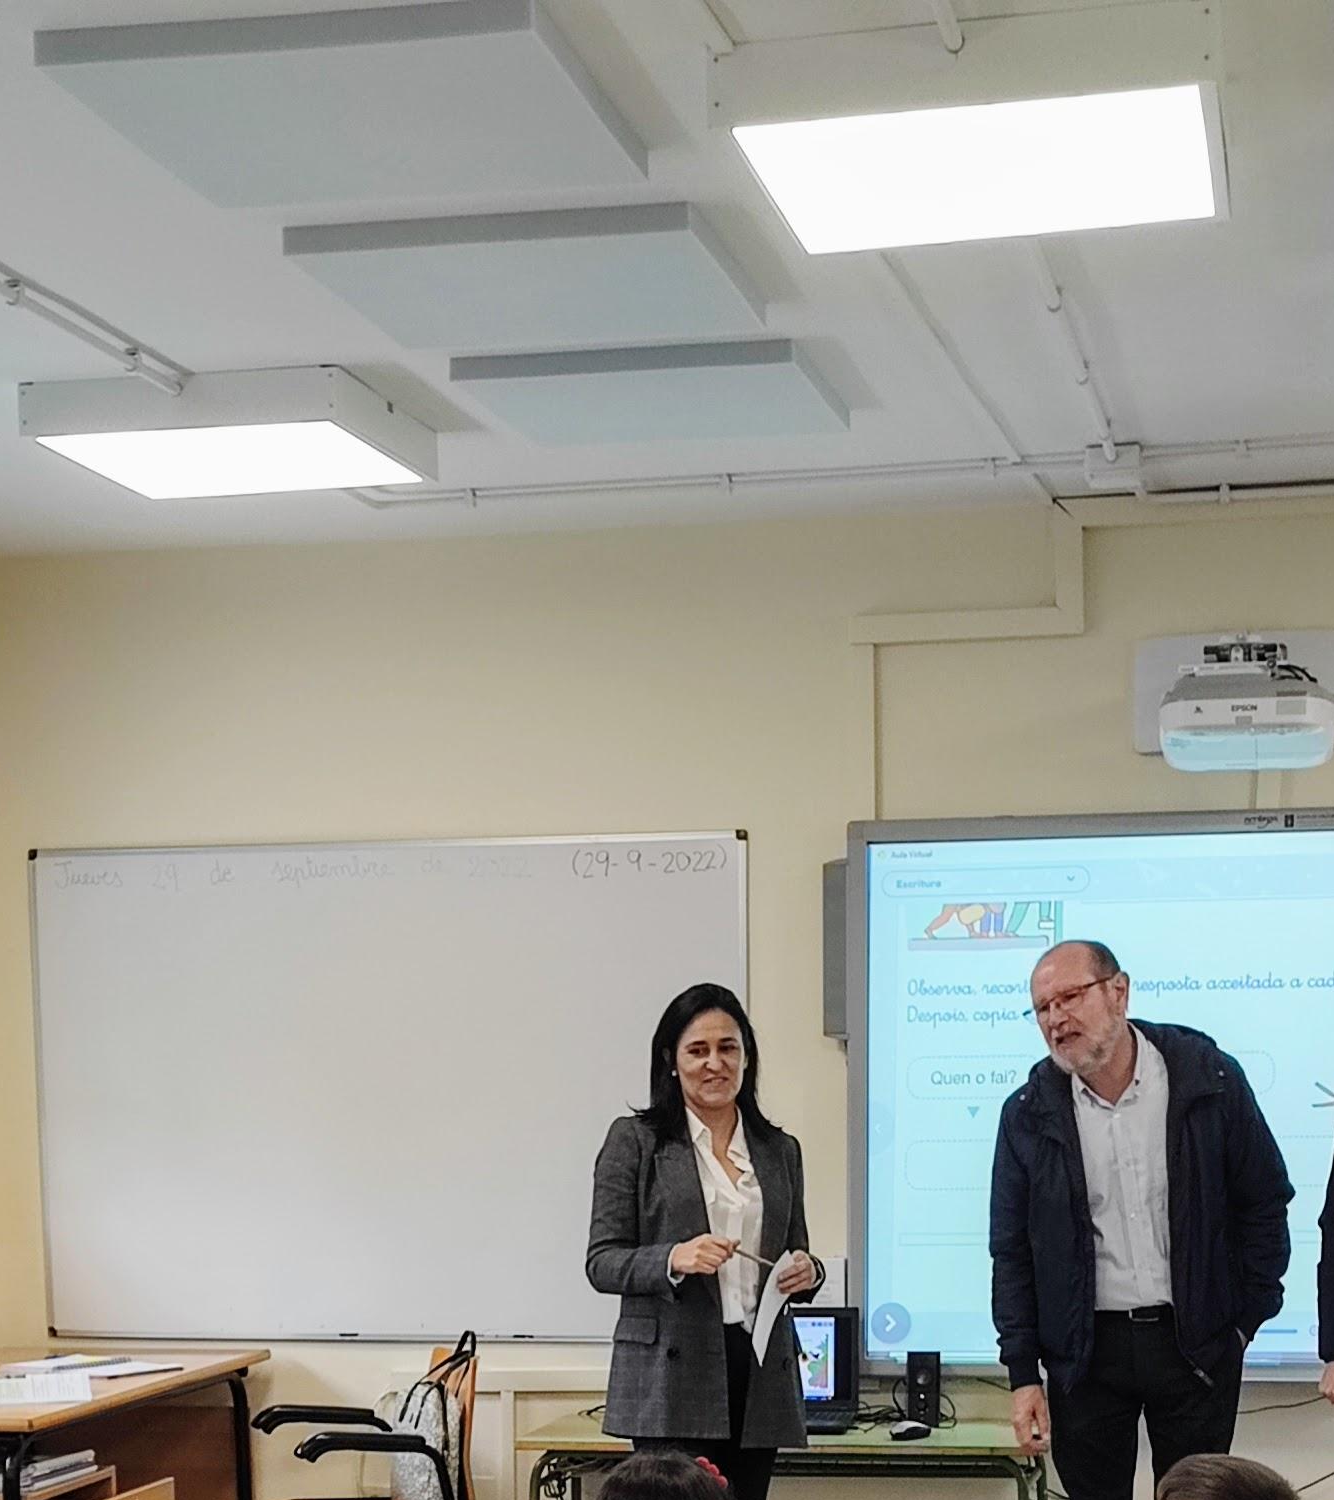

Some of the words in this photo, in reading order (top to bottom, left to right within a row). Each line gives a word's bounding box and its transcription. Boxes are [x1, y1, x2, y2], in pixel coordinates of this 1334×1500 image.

[1231, 704, 1258, 713] EPSON
[209, 858, 235, 887] de
[907, 979, 975, 997] Observa,
[982, 980, 1030, 995] recort
[1133, 975, 1201, 998] resposta
[1206, 972, 1285, 990] axeitada
[1289, 977, 1302, 989] a
[907, 1004, 968, 1029] Despois,
[973, 1009, 1018, 1027] copia
[931, 1070, 969, 1086] Quen
[976, 1075, 986, 1085] o
[991, 1069, 1017, 1085] fai?
